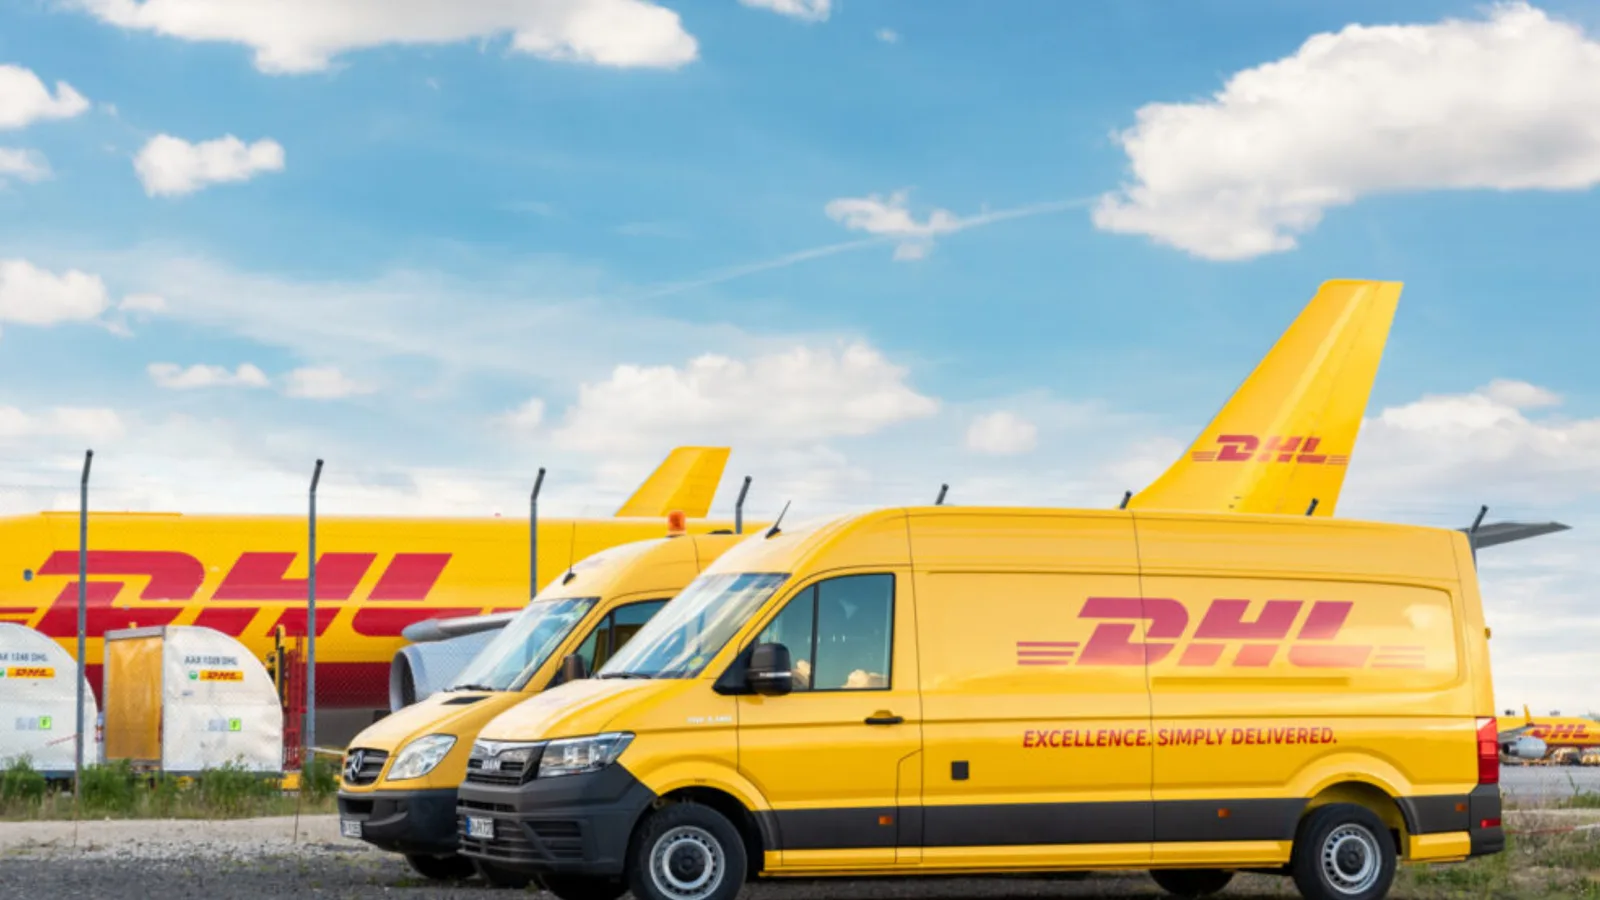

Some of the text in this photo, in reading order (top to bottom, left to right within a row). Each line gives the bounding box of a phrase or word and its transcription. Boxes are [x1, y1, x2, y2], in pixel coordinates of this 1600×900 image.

[1216, 434, 1327, 464] DHL
[35, 550, 483, 637] DHL
[1075, 596, 1374, 669] DHL
[15, 667, 47, 677] DHL
[207, 671, 237, 680] DHL
[1023, 727, 1337, 748] EXCELLENCE. SIMPLY DELIVERED.
[1532, 724, 1590, 738] DHL
